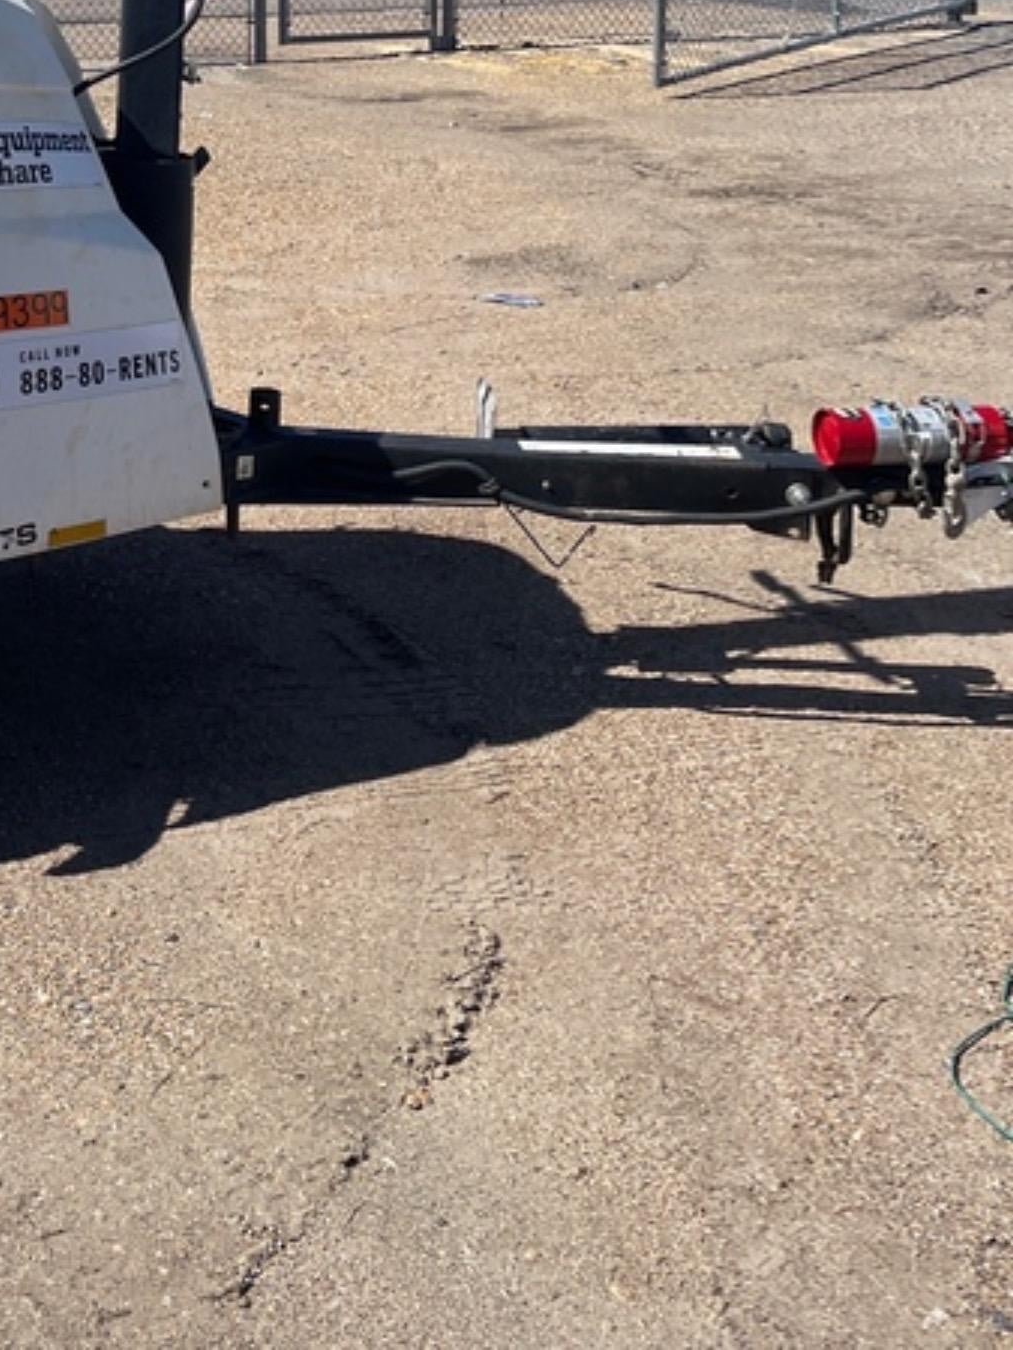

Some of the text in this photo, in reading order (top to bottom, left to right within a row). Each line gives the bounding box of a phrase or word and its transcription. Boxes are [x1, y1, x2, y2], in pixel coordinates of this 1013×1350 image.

[19, 344, 81, 364] CALL NOW
[19, 349, 181, 396] 888-80-RENTS
